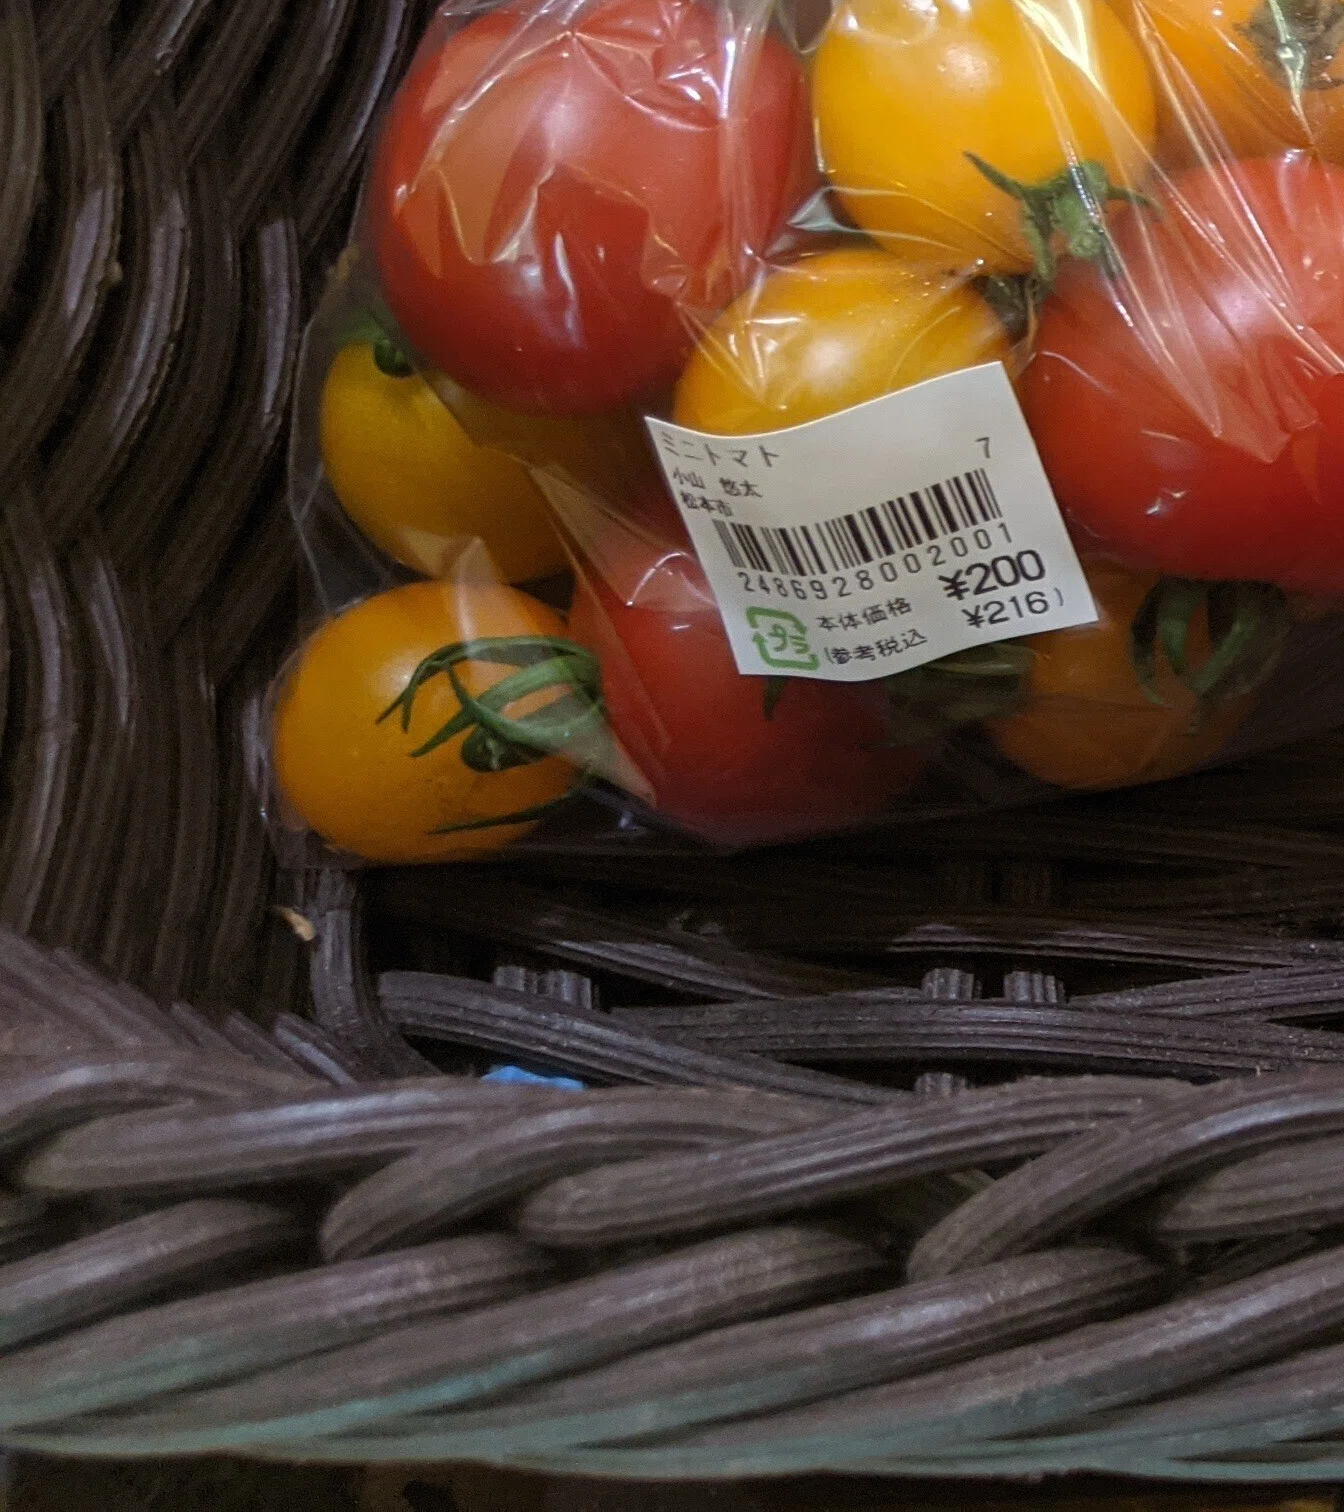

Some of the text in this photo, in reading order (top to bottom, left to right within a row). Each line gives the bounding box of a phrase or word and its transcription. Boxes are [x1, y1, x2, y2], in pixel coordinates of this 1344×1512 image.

[661, 431, 780, 468] ミニトマト
[975, 436, 993, 461] 7
[737, 521, 1014, 601] 2486928002001
[815, 548, 1047, 633] 本体価格 ¥200
